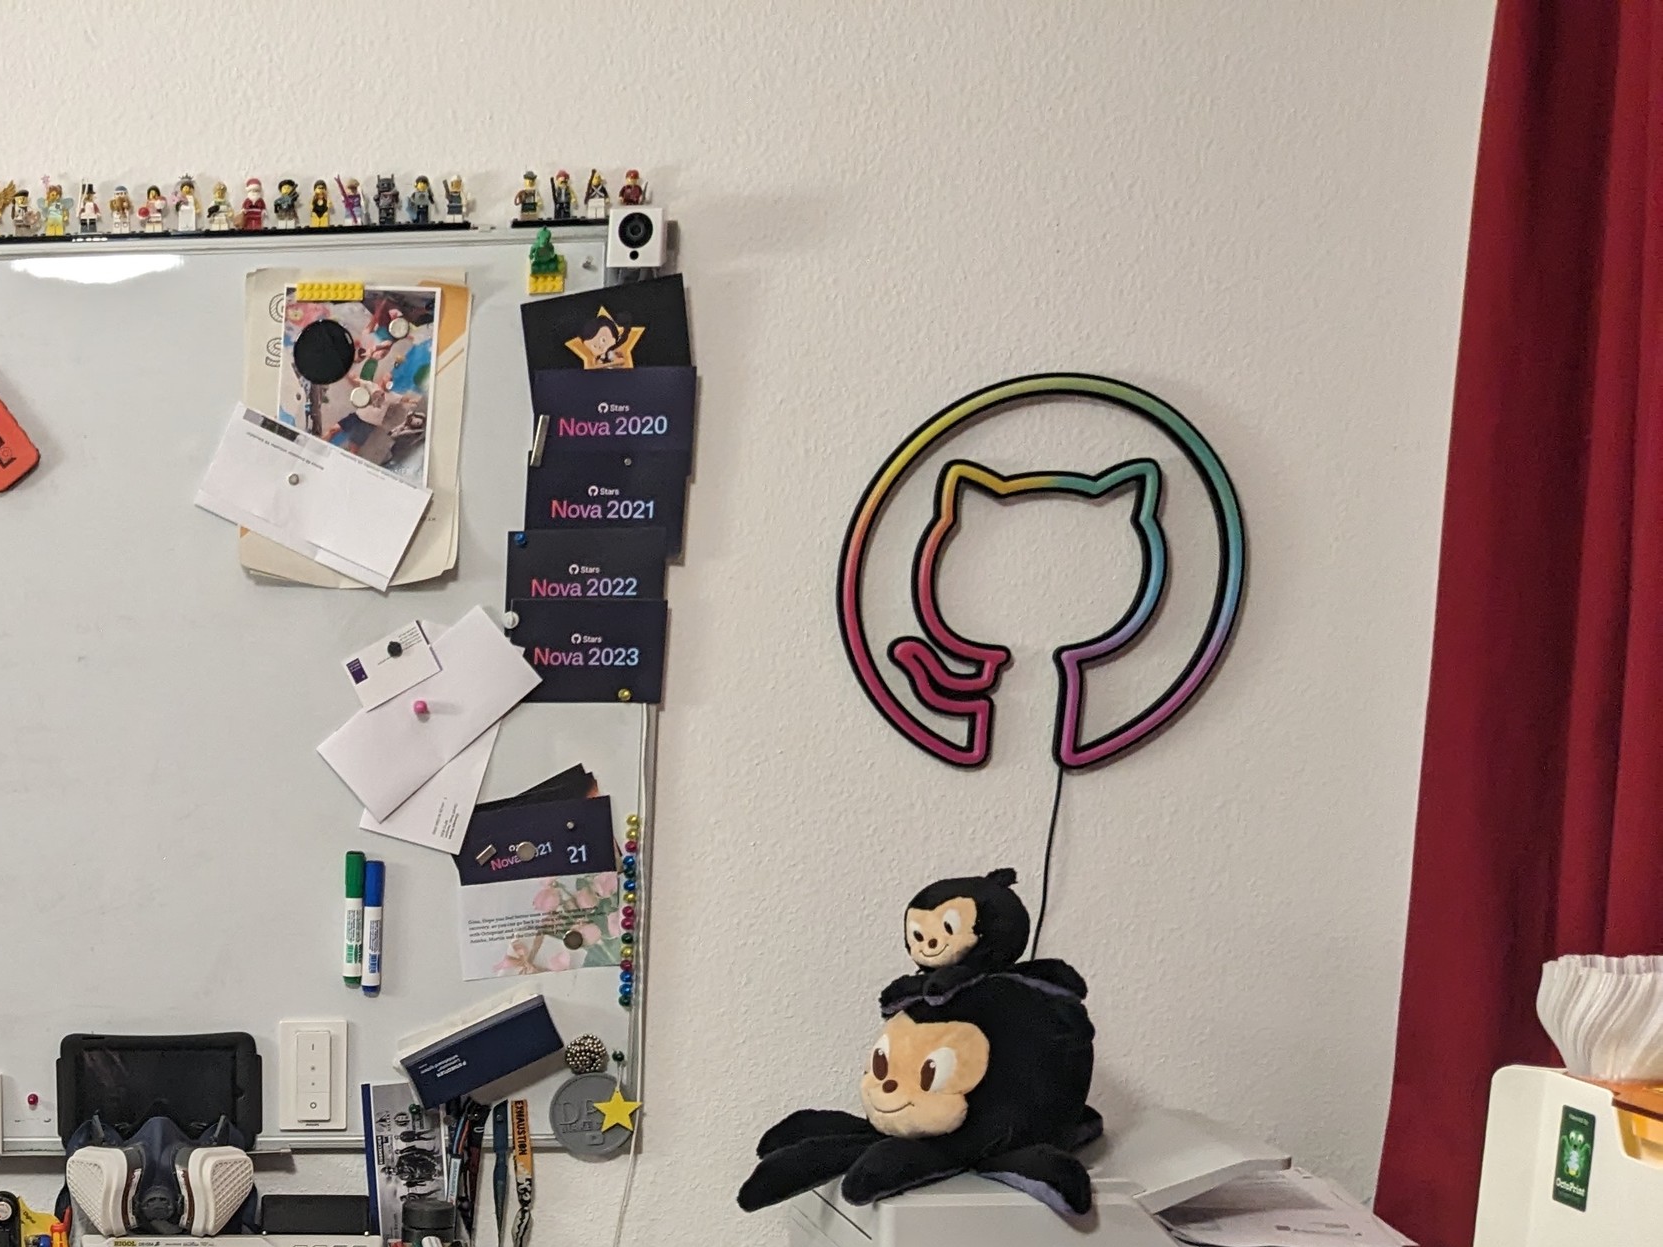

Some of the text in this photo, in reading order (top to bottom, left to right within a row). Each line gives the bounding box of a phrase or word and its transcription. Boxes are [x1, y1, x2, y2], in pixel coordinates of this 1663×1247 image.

[609, 404, 630, 412] Stars
[559, 415, 668, 437] Nova 2020
[599, 487, 620, 496] Stars
[551, 500, 655, 519] Nova 2021
[580, 565, 601, 574] Stars
[531, 577, 638, 597] Nova 2022
[582, 634, 603, 643] Stars
[534, 647, 639, 666] Nova 2023
[514, 1100, 528, 1155] EXHAUSTION
[1555, 1177, 1586, 1197] OctoPrint
